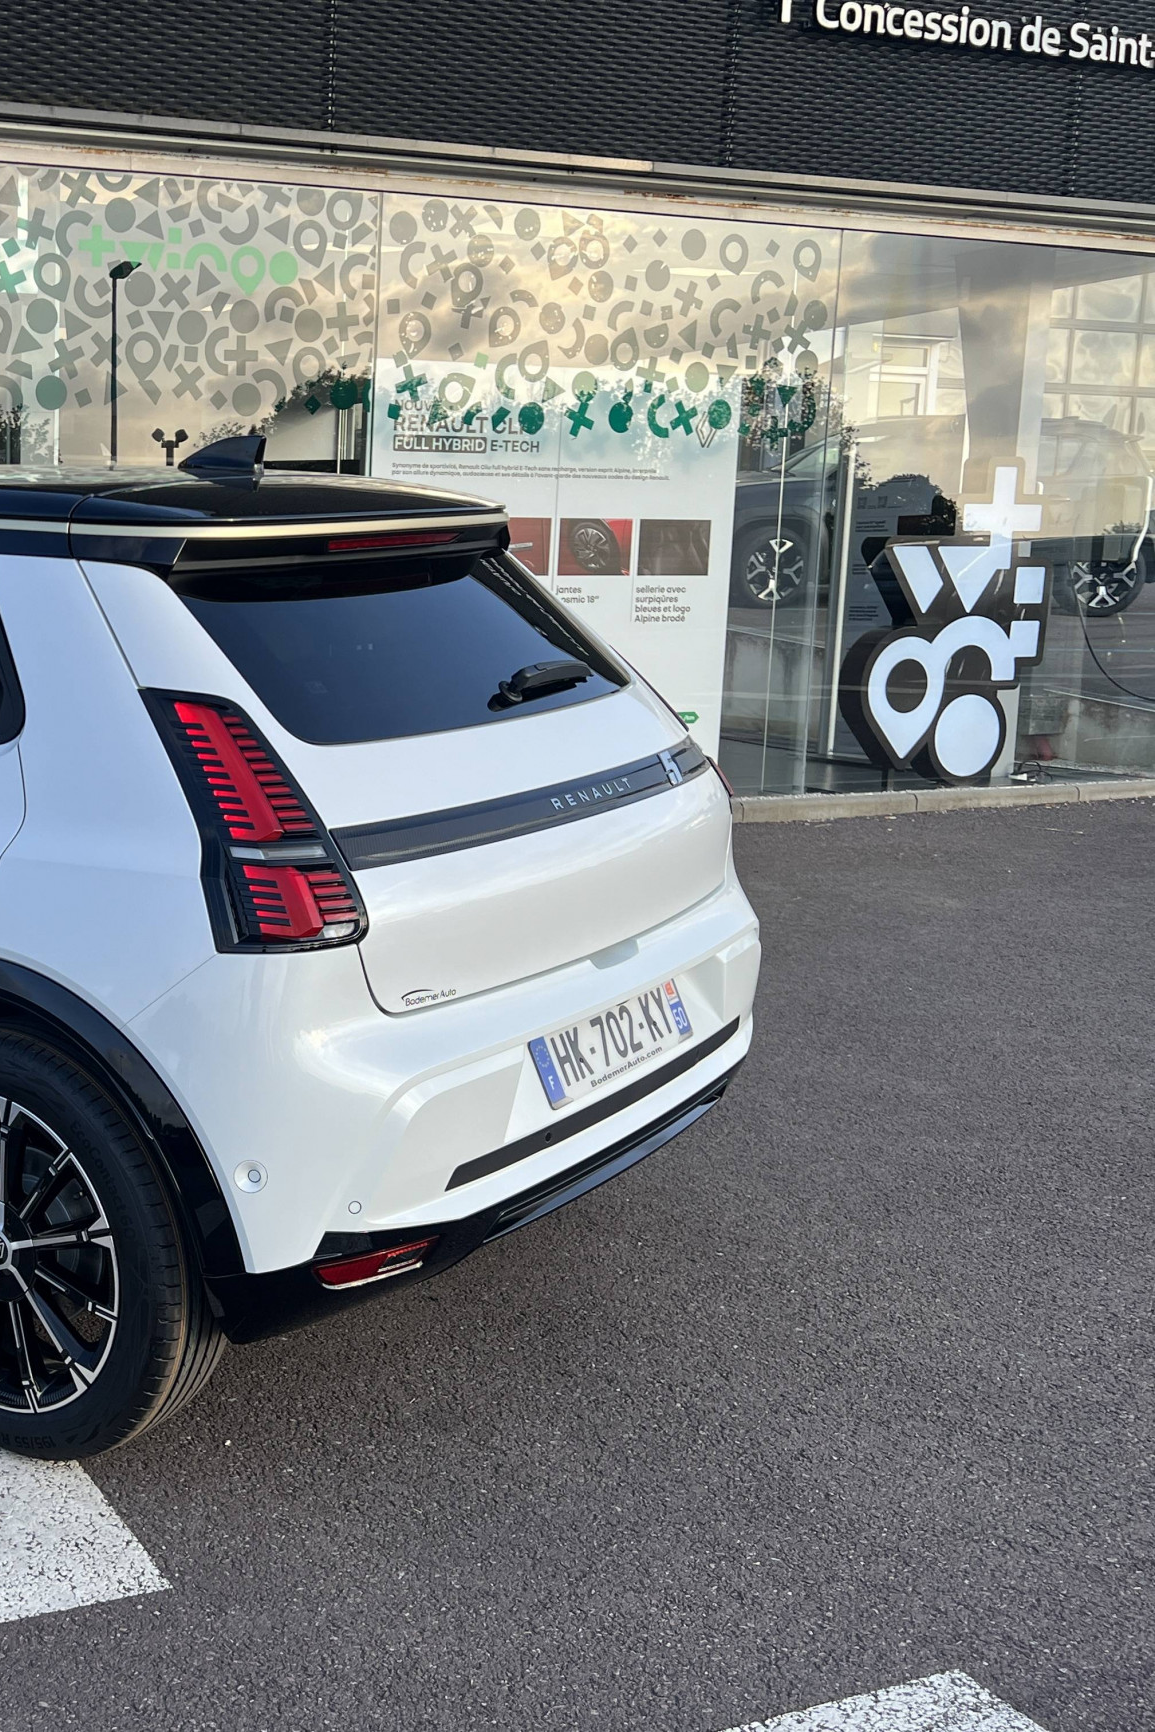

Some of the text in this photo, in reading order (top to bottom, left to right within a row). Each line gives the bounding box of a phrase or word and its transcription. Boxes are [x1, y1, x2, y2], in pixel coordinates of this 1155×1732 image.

[816, 0, 1012, 50] Concession
[1020, 16, 1064, 56] de
[395, 437, 540, 453] FULL HYBRID E-TECH
[555, 586, 582, 595] jantes
[636, 585, 665, 594] sellerie
[635, 595, 679, 605] surpiqûres
[635, 605, 662, 613] bleues
[673, 605, 691, 615] logo
[635, 614, 686, 625] Alpine brodé
[550, 777, 632, 811] RENAULT
[548, 987, 688, 1091] F HK-702-KY 50
[590, 1045, 663, 1088] BodemerAuto.com
